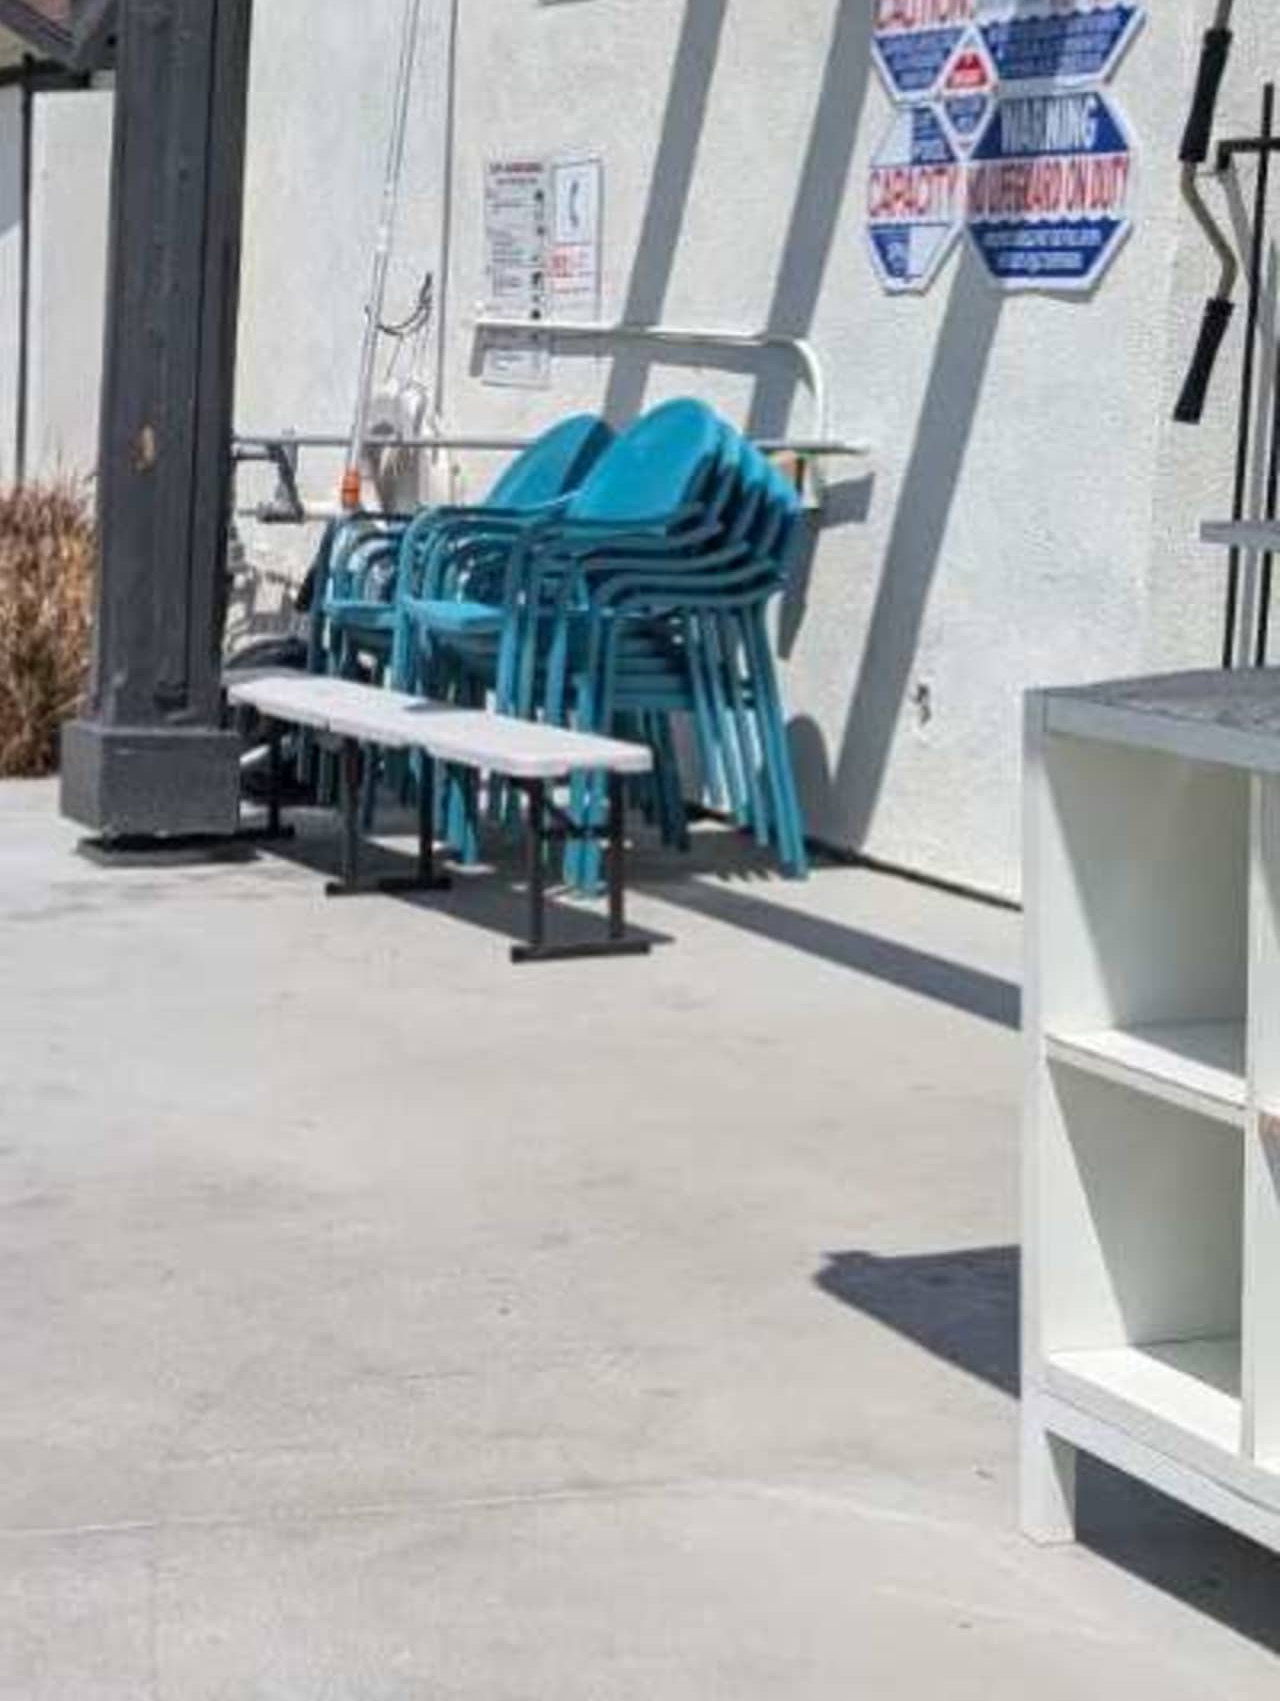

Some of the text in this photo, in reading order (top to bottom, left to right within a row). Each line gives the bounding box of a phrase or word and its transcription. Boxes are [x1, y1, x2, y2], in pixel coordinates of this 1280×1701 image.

[1000, 95, 1098, 152] WARNING
[869, 165, 961, 218] CAPACITY
[988, 159, 1063, 213] LIFEGUARD
[1066, 158, 1086, 211] ON
[1089, 155, 1130, 209] DUTY
